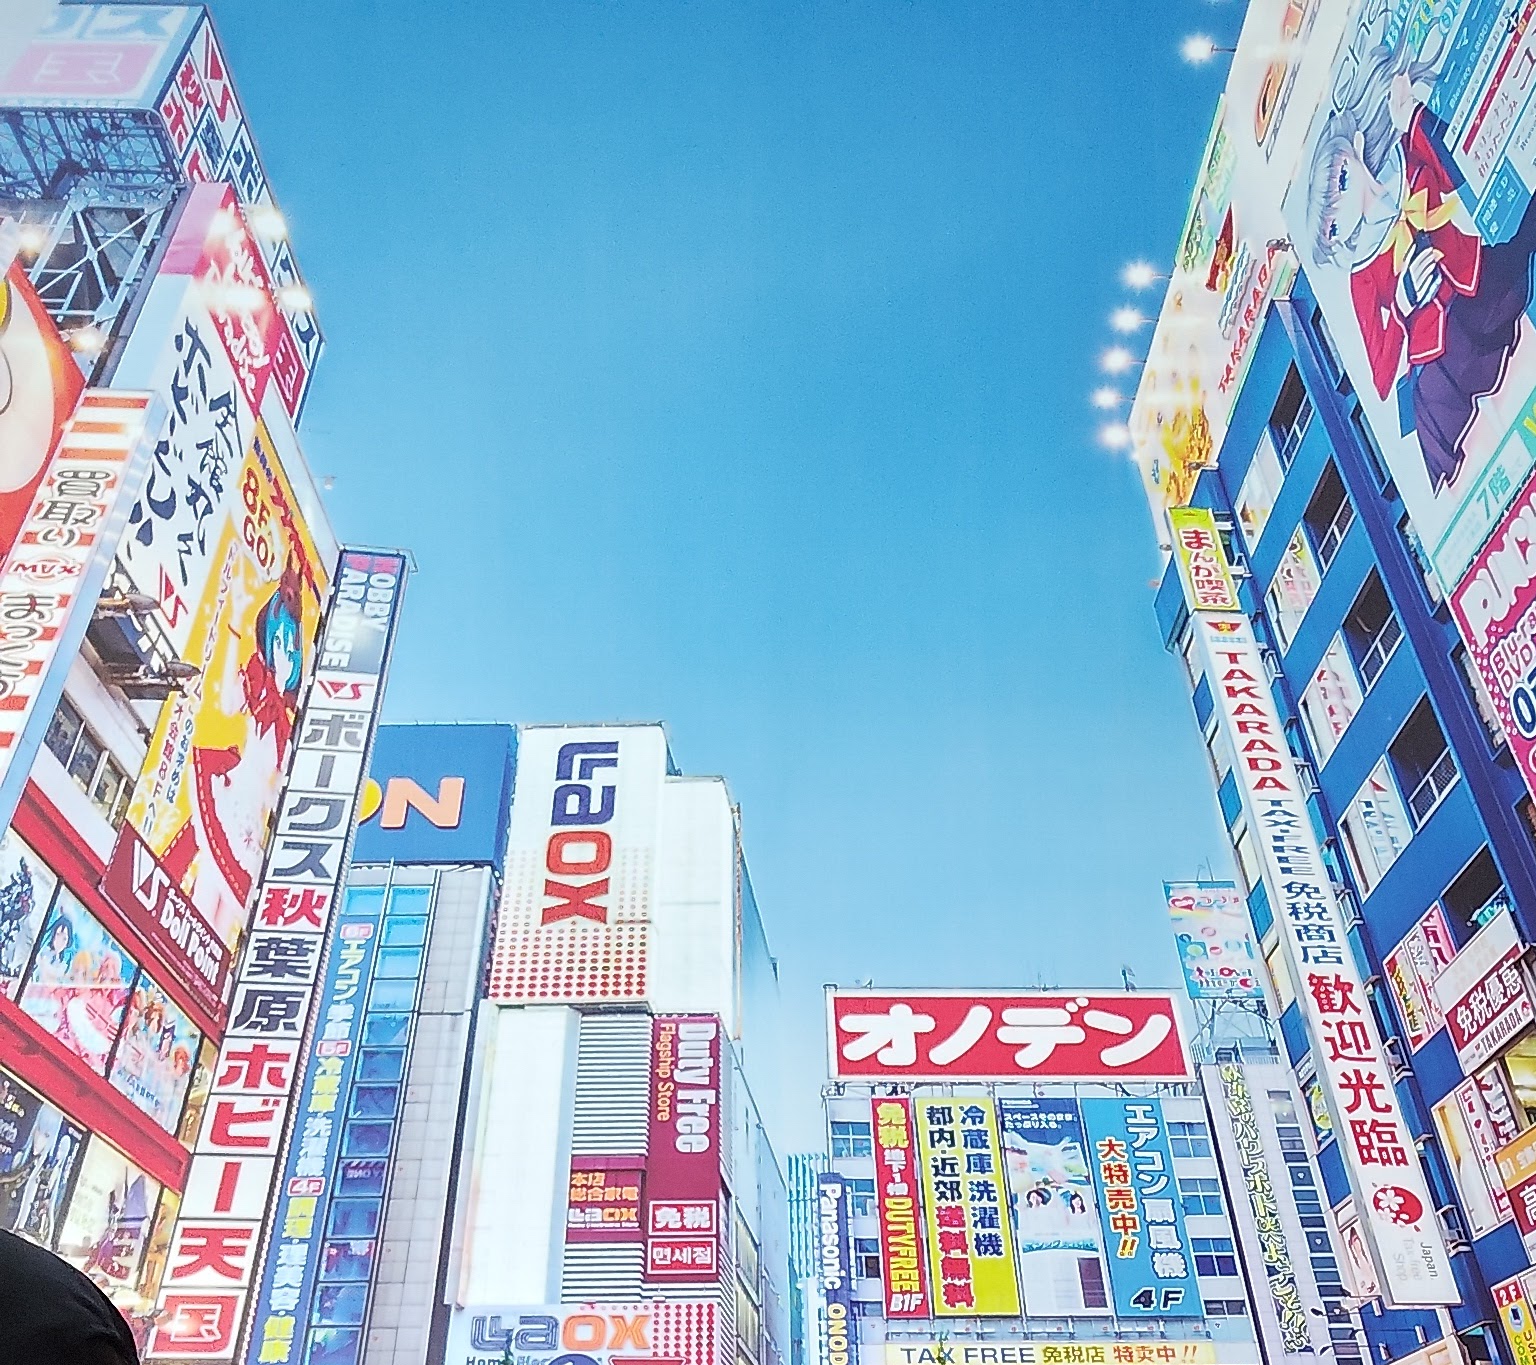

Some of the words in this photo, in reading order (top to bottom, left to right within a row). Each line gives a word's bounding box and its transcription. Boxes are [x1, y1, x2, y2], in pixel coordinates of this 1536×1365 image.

[363, 555, 403, 632] HOBBY
[1181, 528, 1235, 606] まんが喫茶
[1215, 651, 1292, 792] TAKARADA
[1282, 880, 1345, 966] 免税商店
[656, 1022, 676, 1079] Flagship
[676, 1022, 717, 1086] Duty
[839, 997, 1173, 1069] オノデン
[1480, 1007, 1524, 1054] TAKARADA
[655, 1081, 675, 1122] Store
[675, 1089, 715, 1154] Free
[819, 1184, 843, 1291] Panasonic
[1130, 1286, 1186, 1310] 4F
[1500, 1286, 1521, 1307] 2F
[900, 1347, 955, 1364] TAX
[964, 1347, 1036, 1364] FREE
[1042, 1345, 1105, 1364] 免税店
